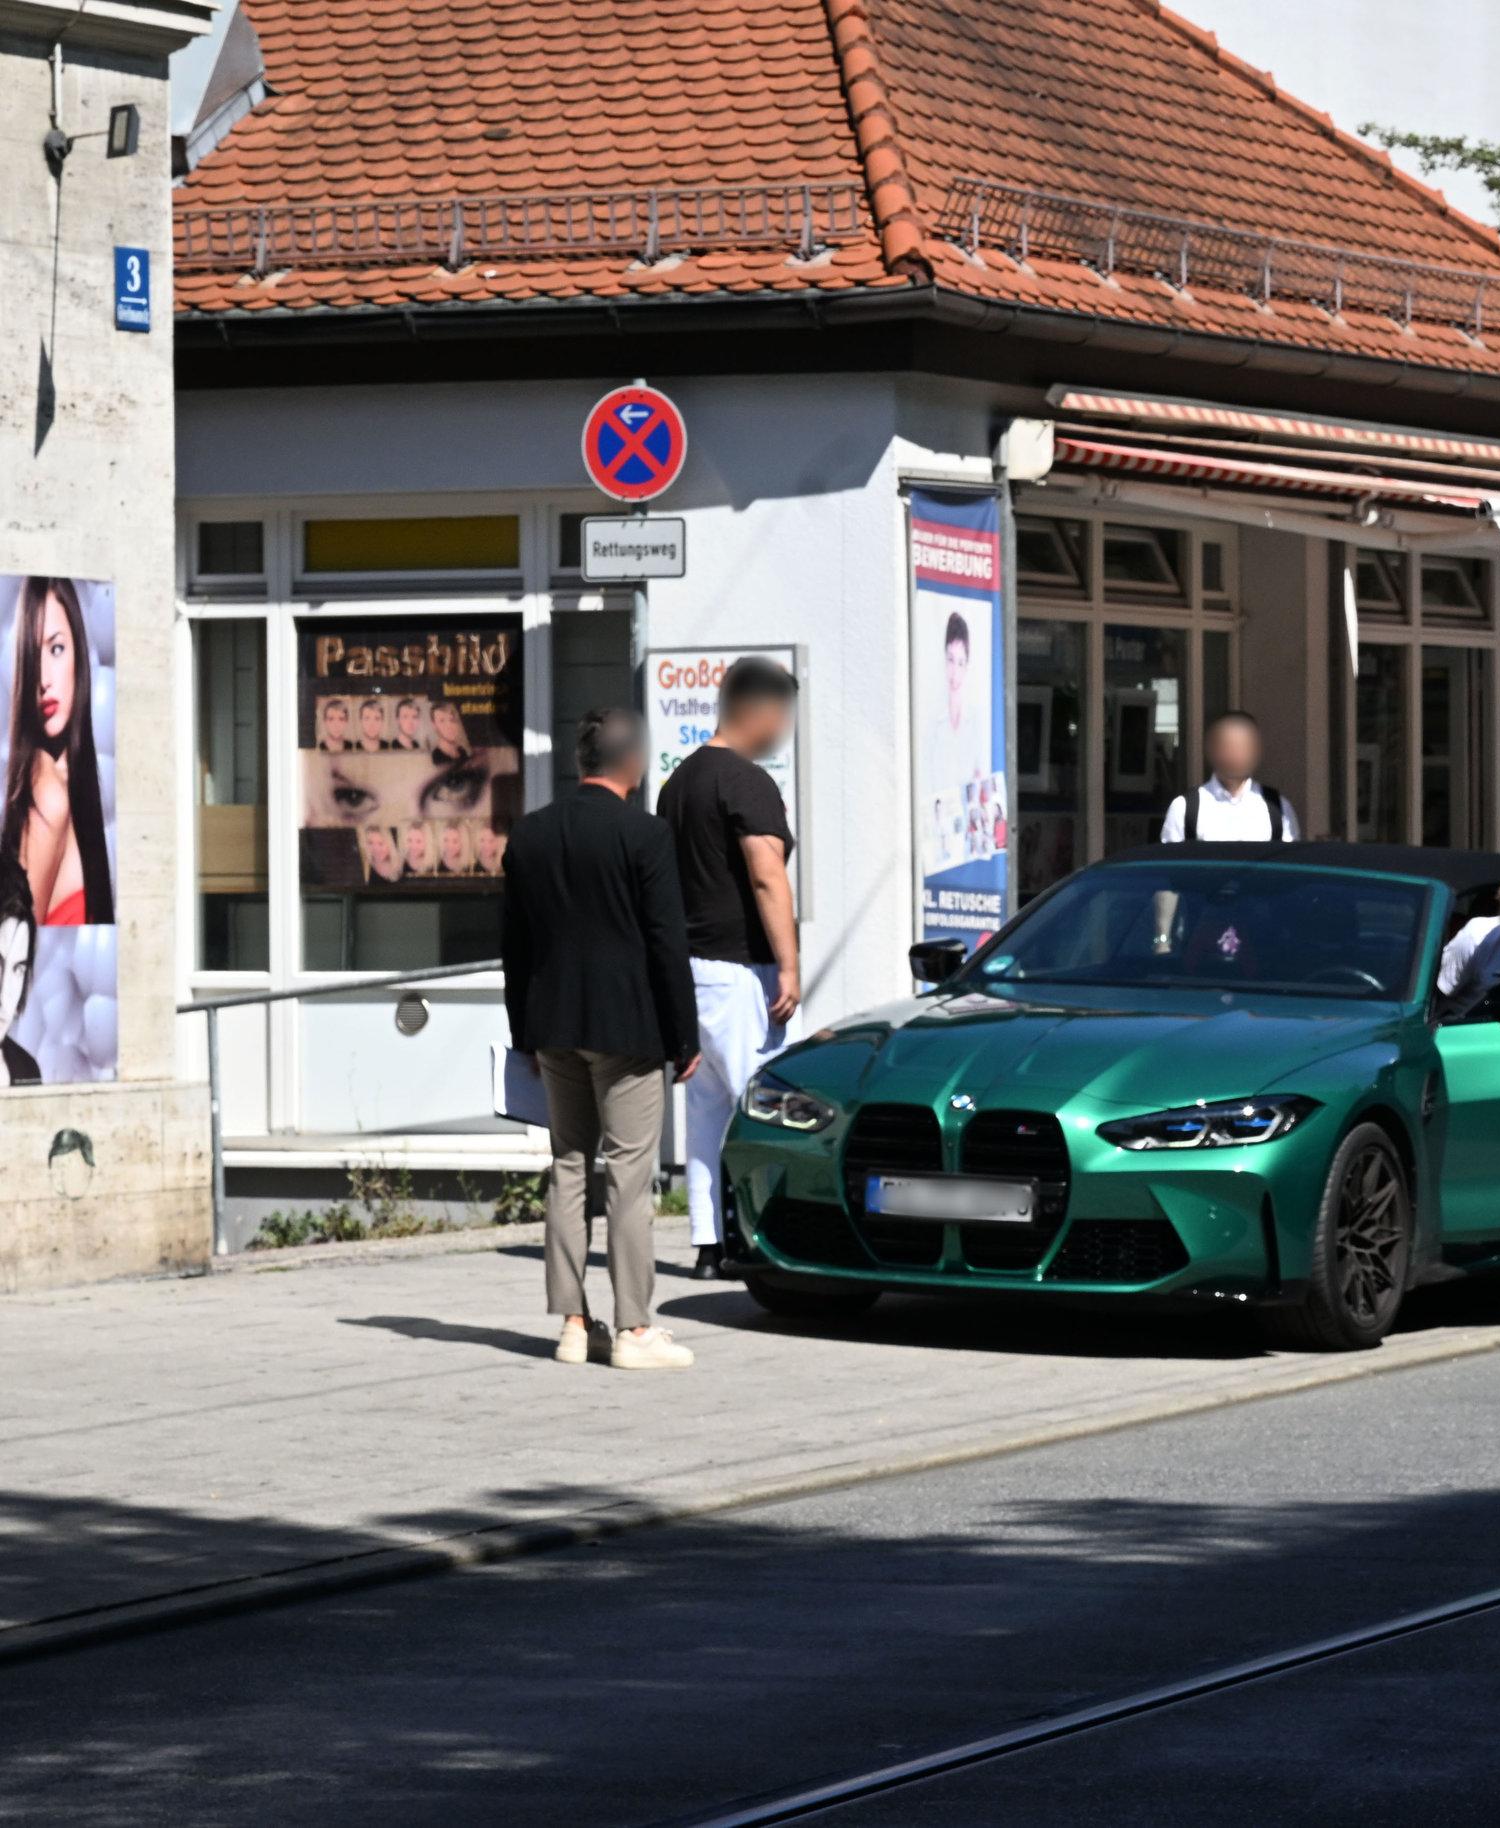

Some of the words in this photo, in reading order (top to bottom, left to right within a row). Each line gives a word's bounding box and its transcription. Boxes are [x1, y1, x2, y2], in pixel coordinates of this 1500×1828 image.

[126, 255, 141, 293] 3
[593, 541, 677, 561] Rettungsweg
[315, 632, 508, 679] Passbild
[658, 659, 727, 689] Großd
[679, 723, 712, 746] Ste
